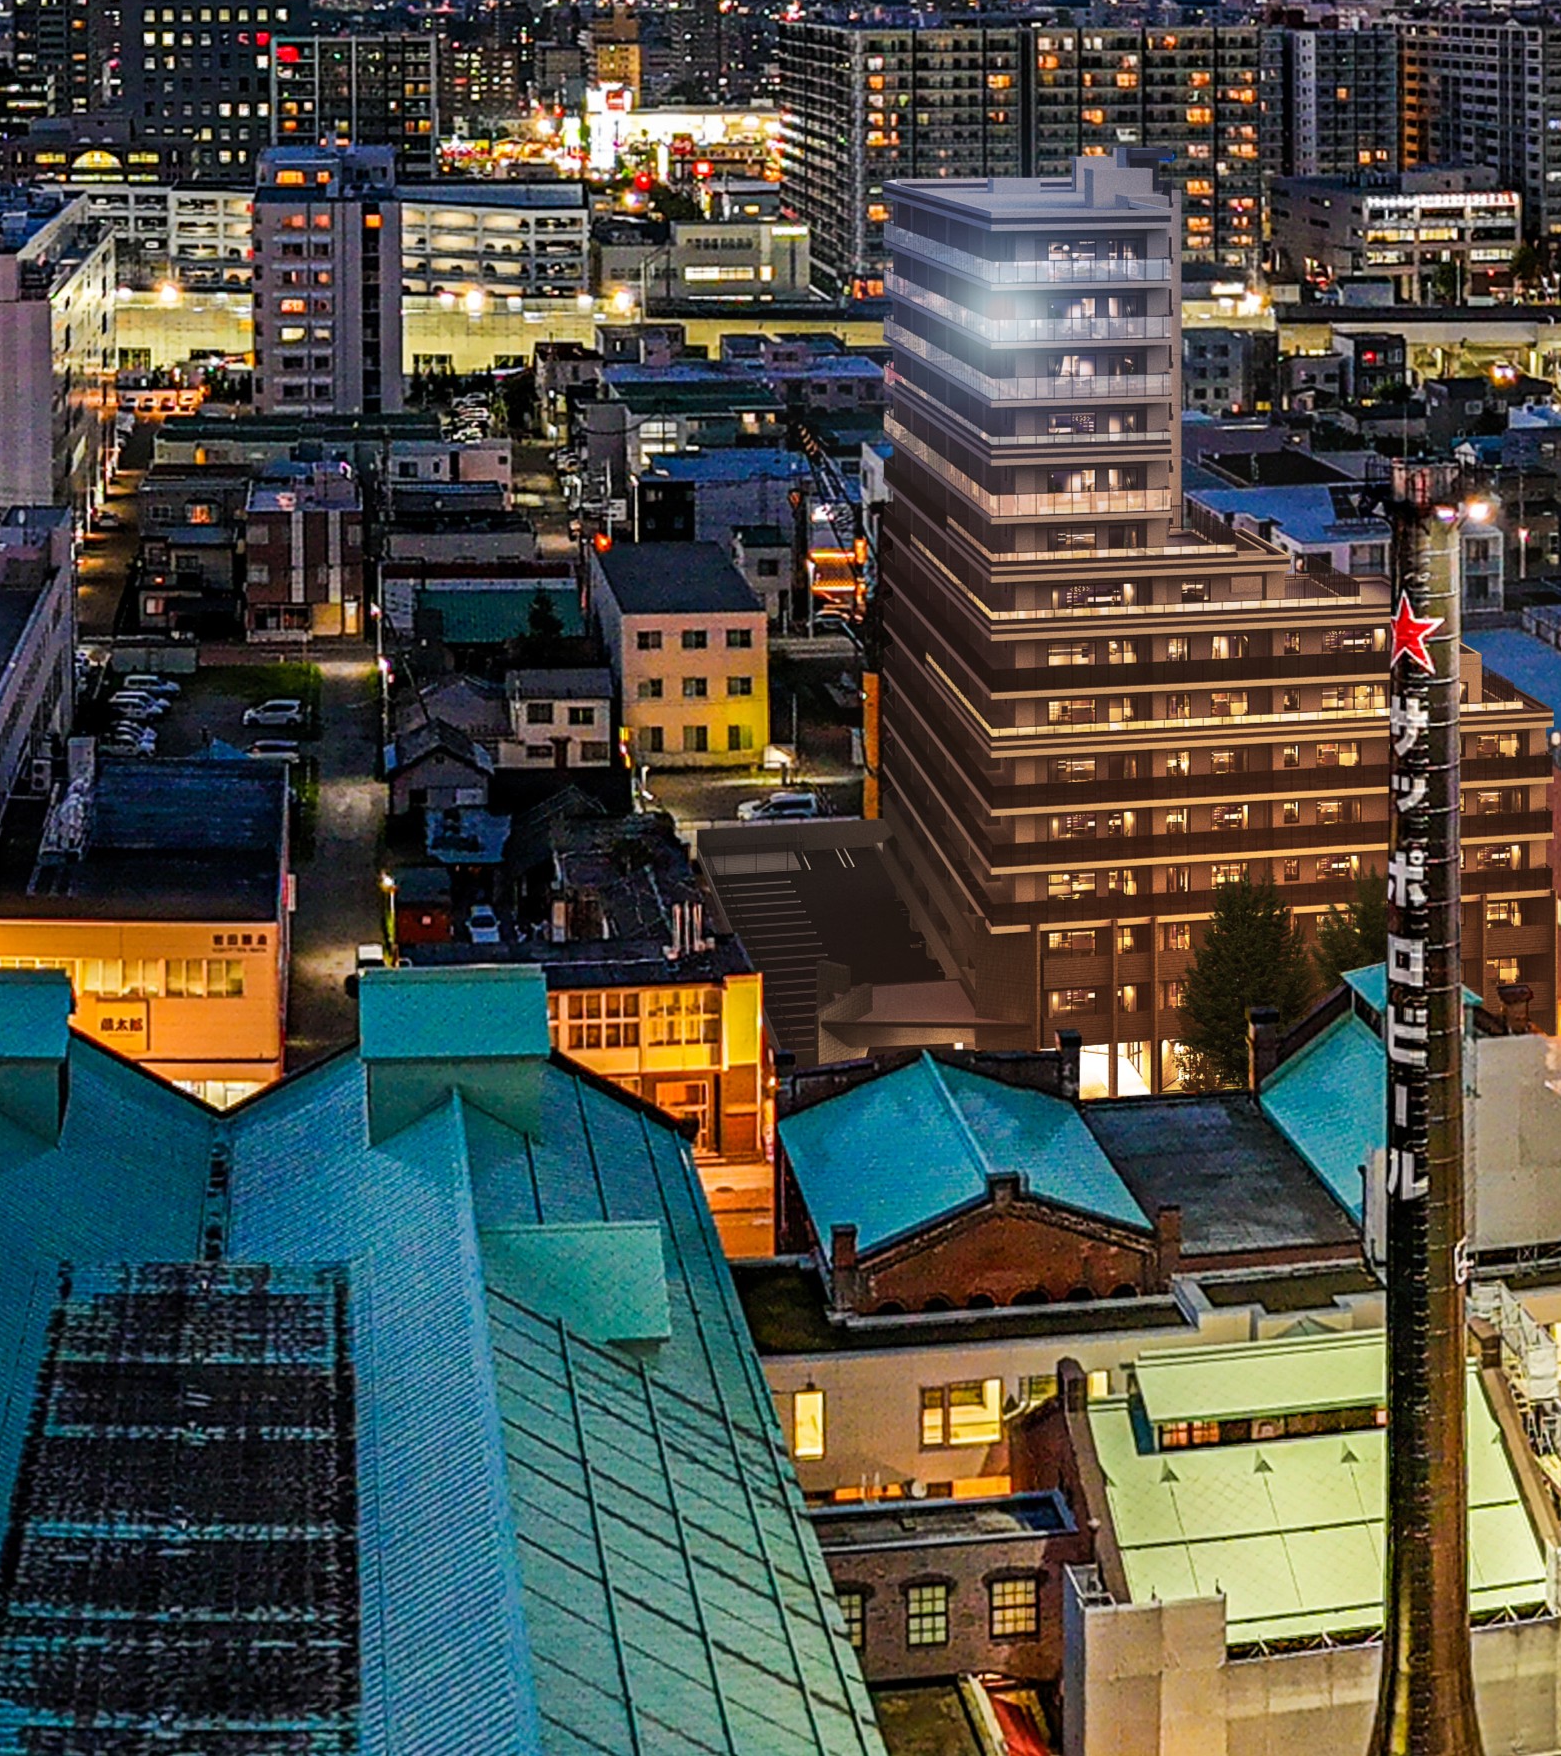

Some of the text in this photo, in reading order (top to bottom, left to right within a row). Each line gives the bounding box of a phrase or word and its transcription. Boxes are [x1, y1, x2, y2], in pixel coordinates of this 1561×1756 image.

[1387, 695, 1429, 1201] サッポロビール
